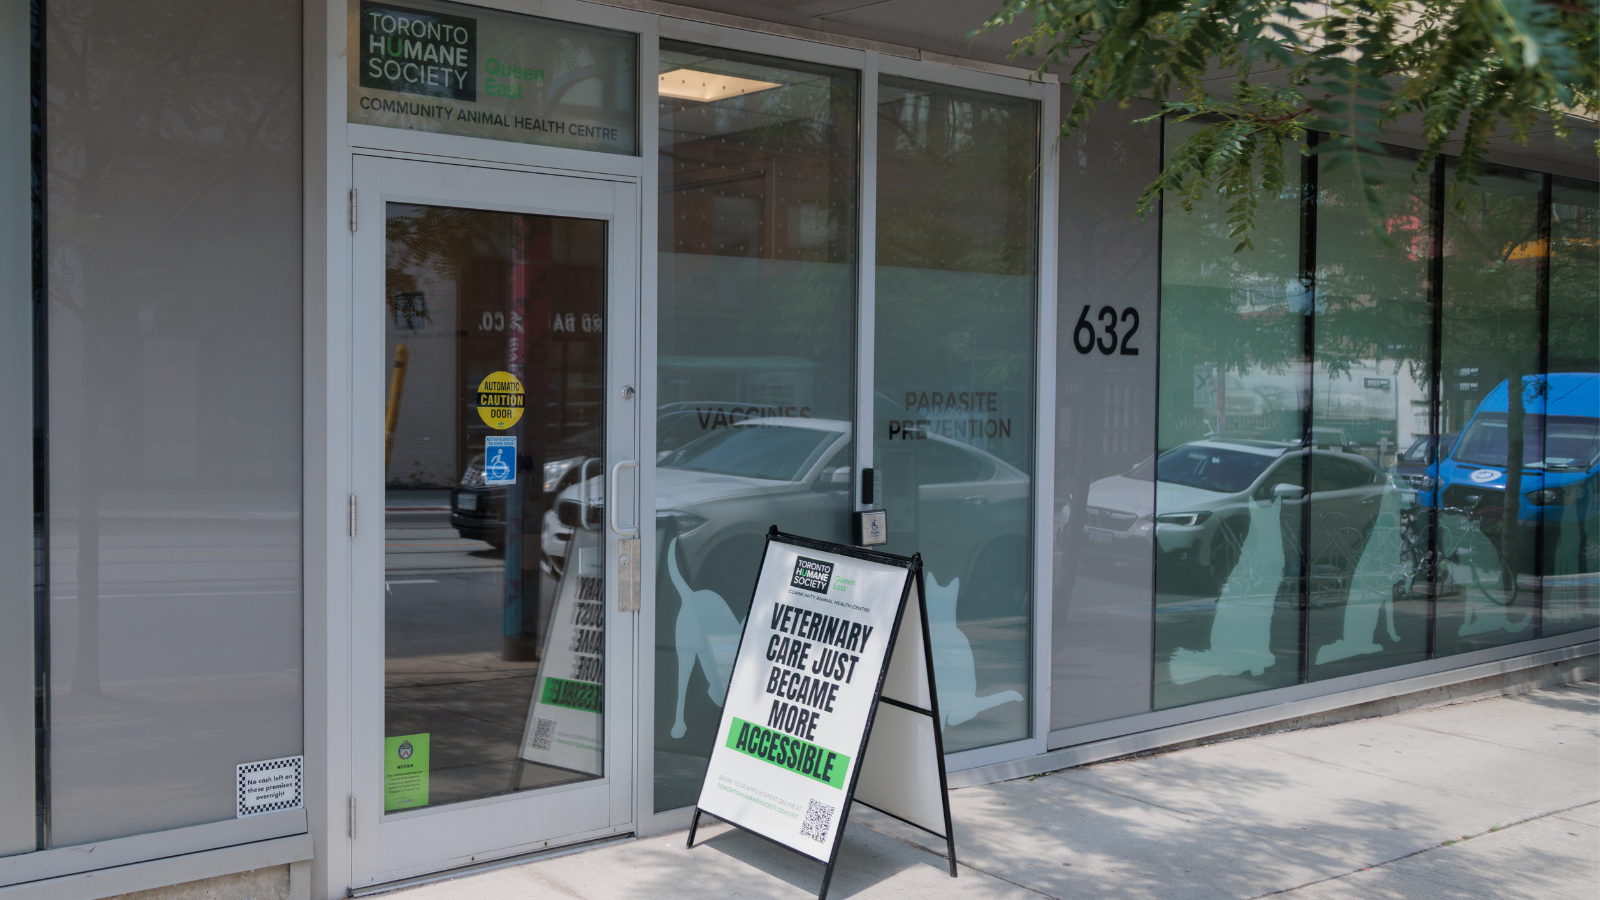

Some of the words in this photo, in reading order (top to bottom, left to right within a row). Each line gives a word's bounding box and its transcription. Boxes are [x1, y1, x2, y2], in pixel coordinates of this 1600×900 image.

[369, 12, 468, 45] TORONTO
[369, 34, 468, 68] HUMANE
[368, 58, 468, 90] SOCIETY
[485, 58, 545, 83] Queen
[485, 78, 524, 100] East
[360, 96, 453, 120] COMMUNITY
[457, 109, 510, 128] ANIMAL
[514, 116, 565, 134] HEALTH
[568, 123, 618, 141] CENTRE
[1073, 305, 1140, 356] 632
[484, 381, 520, 391] AUTOMATIC
[480, 394, 524, 406] CAUTION
[905, 391, 998, 413] PARASITE
[491, 409, 513, 419] DOOR
[696, 406, 812, 430] VACCINES
[889, 418, 1011, 440] PREVENTION
[796, 568, 830, 582] HUMANE
[798, 559, 831, 573] TORONTO
[793, 576, 828, 590] SOCIETY
[833, 583, 847, 592] East
[835, 575, 856, 586] Queen
[788, 589, 816, 600] COMMUNITY
[816, 596, 833, 604] ANIMAL
[834, 600, 852, 609] HEALTH
[852, 604, 870, 613] CENTRE
[770, 602, 874, 654] VETERINARY
[766, 633, 812, 671] CARE
[811, 647, 860, 684] JUST
[766, 665, 840, 713] BECAME
[767, 699, 820, 741] MORE
[735, 722, 837, 783] ACCESSIBLE
[256, 791, 285, 800] overnight
[265, 783, 293, 792] premises
[718, 775, 732, 784] BOOK
[732, 780, 746, 789] YOUR
[746, 786, 778, 802] APPOINTMENT
[778, 798, 795, 809] ONLINE
[717, 783, 799, 820] TORONTOHUMANESOCIETY.COM/VET
